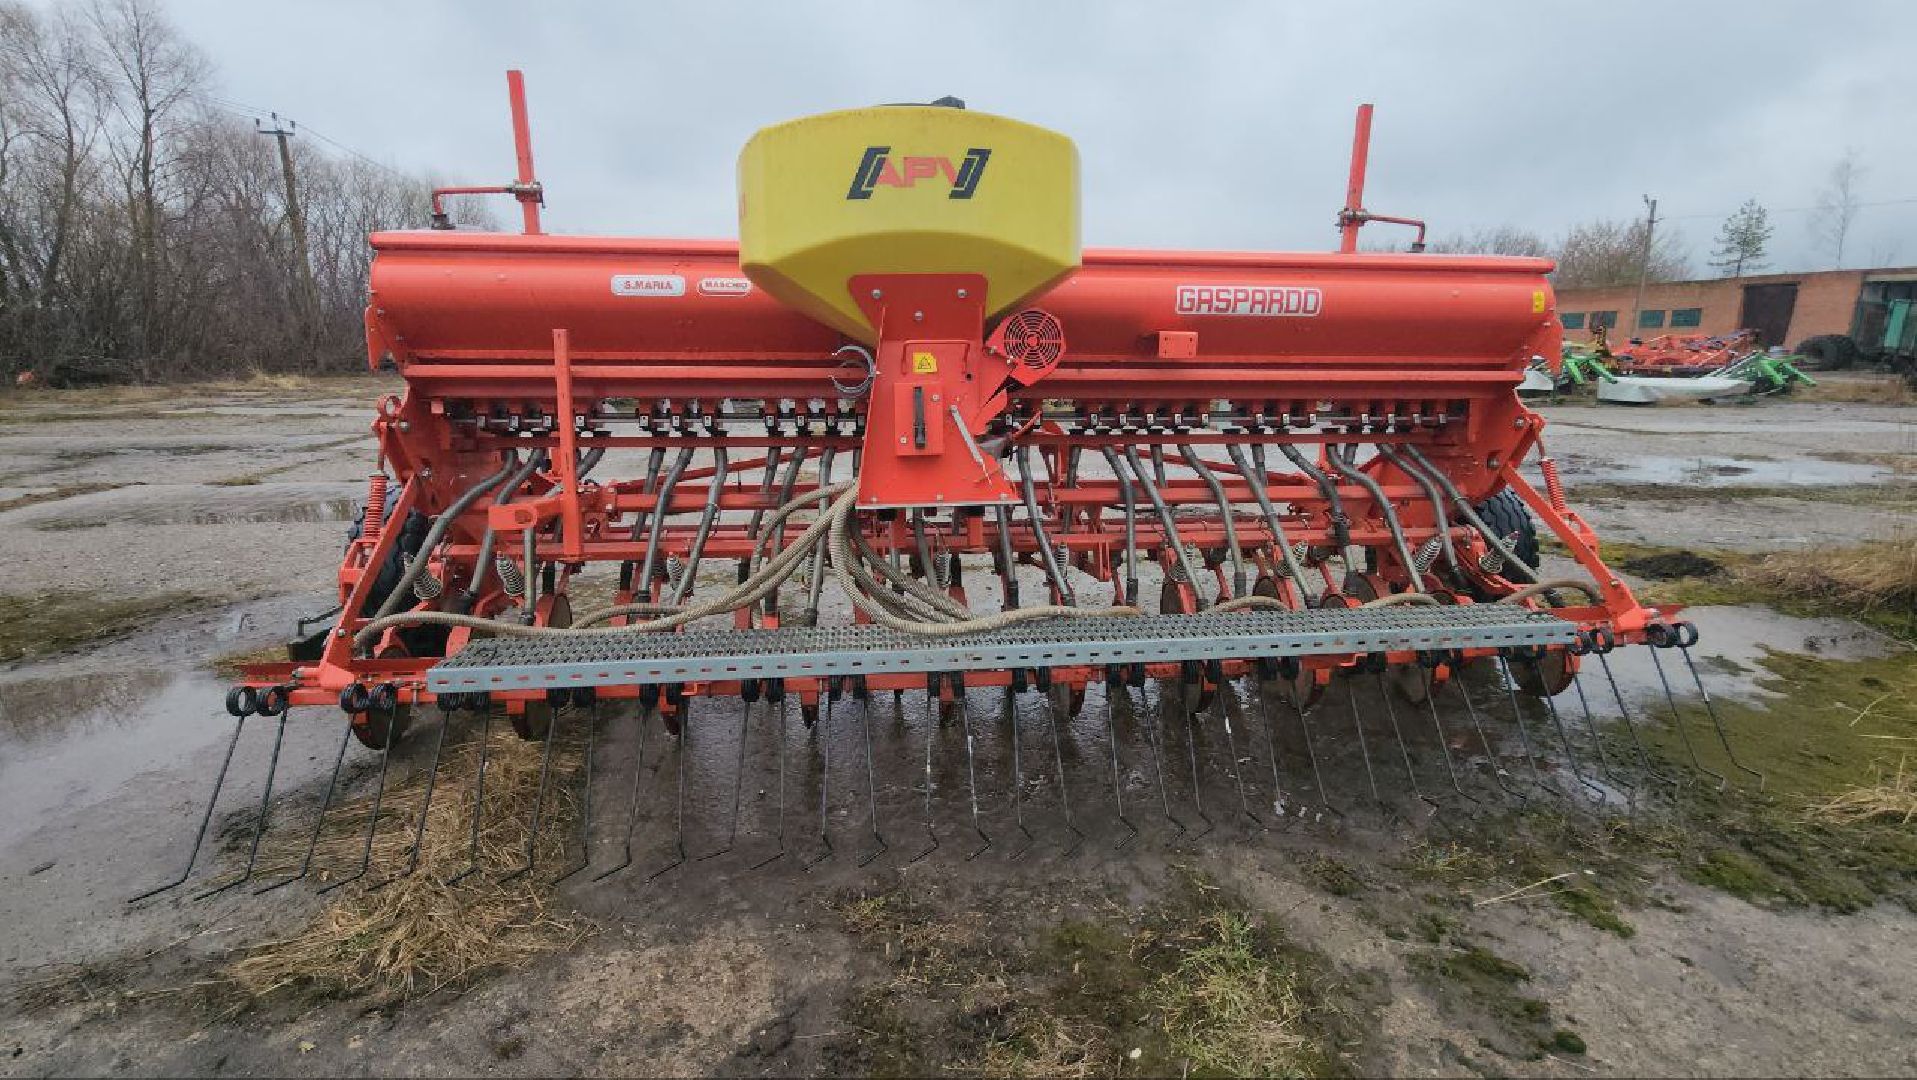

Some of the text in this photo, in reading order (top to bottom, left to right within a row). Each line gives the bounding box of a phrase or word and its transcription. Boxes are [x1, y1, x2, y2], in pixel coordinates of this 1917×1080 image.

[863, 155, 978, 190] APV
[623, 279, 673, 291] S.MARIA
[1177, 288, 1321, 314] GASPARDO
